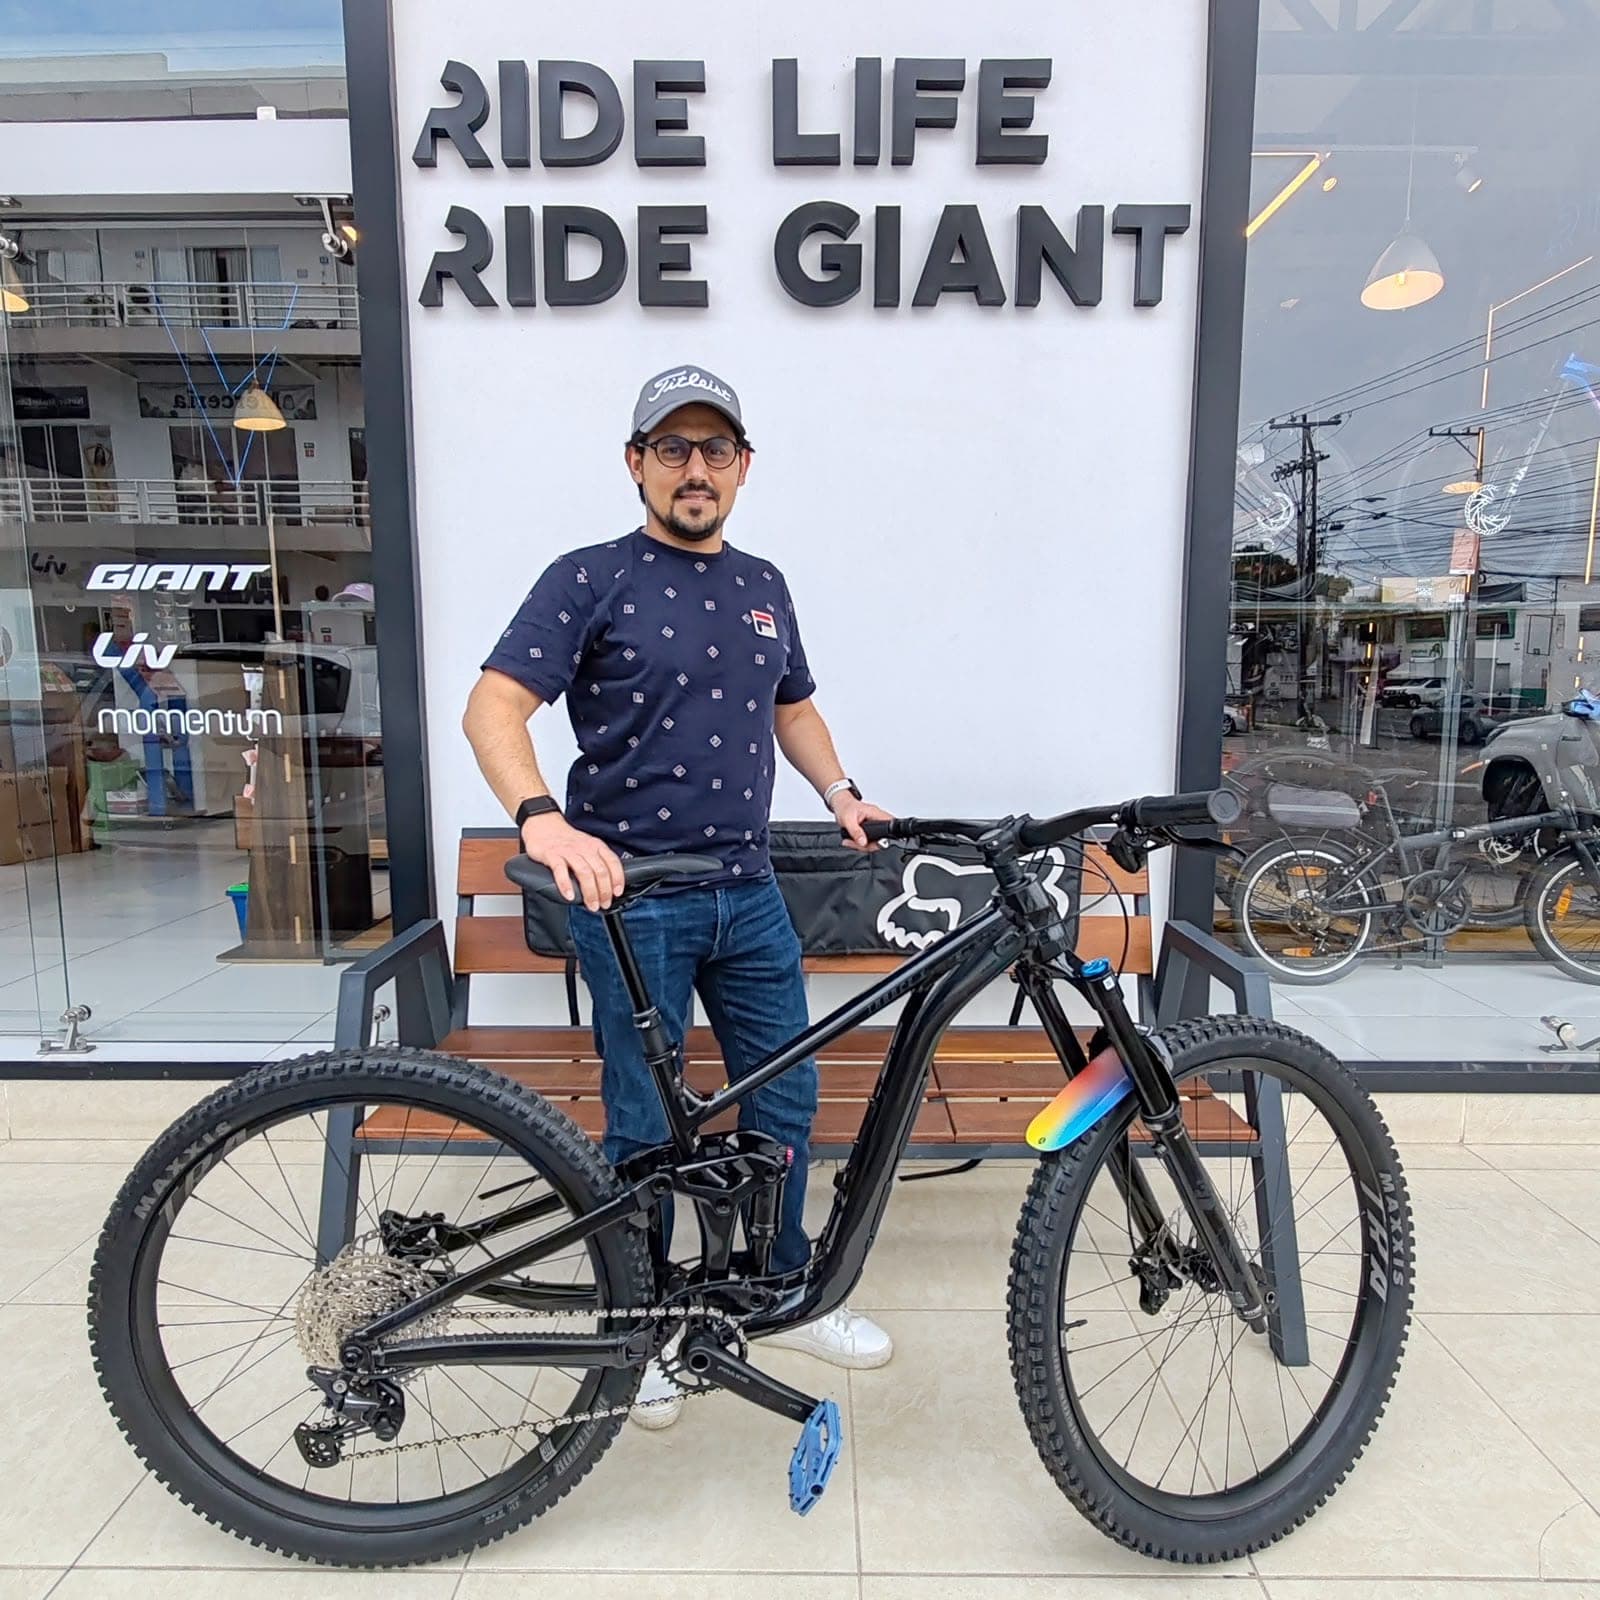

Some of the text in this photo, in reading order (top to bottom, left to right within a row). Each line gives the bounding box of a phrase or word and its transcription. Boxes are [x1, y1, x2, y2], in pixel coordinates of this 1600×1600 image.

[412, 58, 1053, 169] RIDE LIFE
[418, 200, 1193, 308] RIDE GIANT
[648, 369, 732, 403] Titleist
[86, 564, 272, 590] GIANT
[92, 632, 178, 669] Liv
[97, 707, 283, 736] momentum
[134, 1121, 233, 1221] MAXXIS
[1379, 1171, 1405, 1287] MAXXIS
